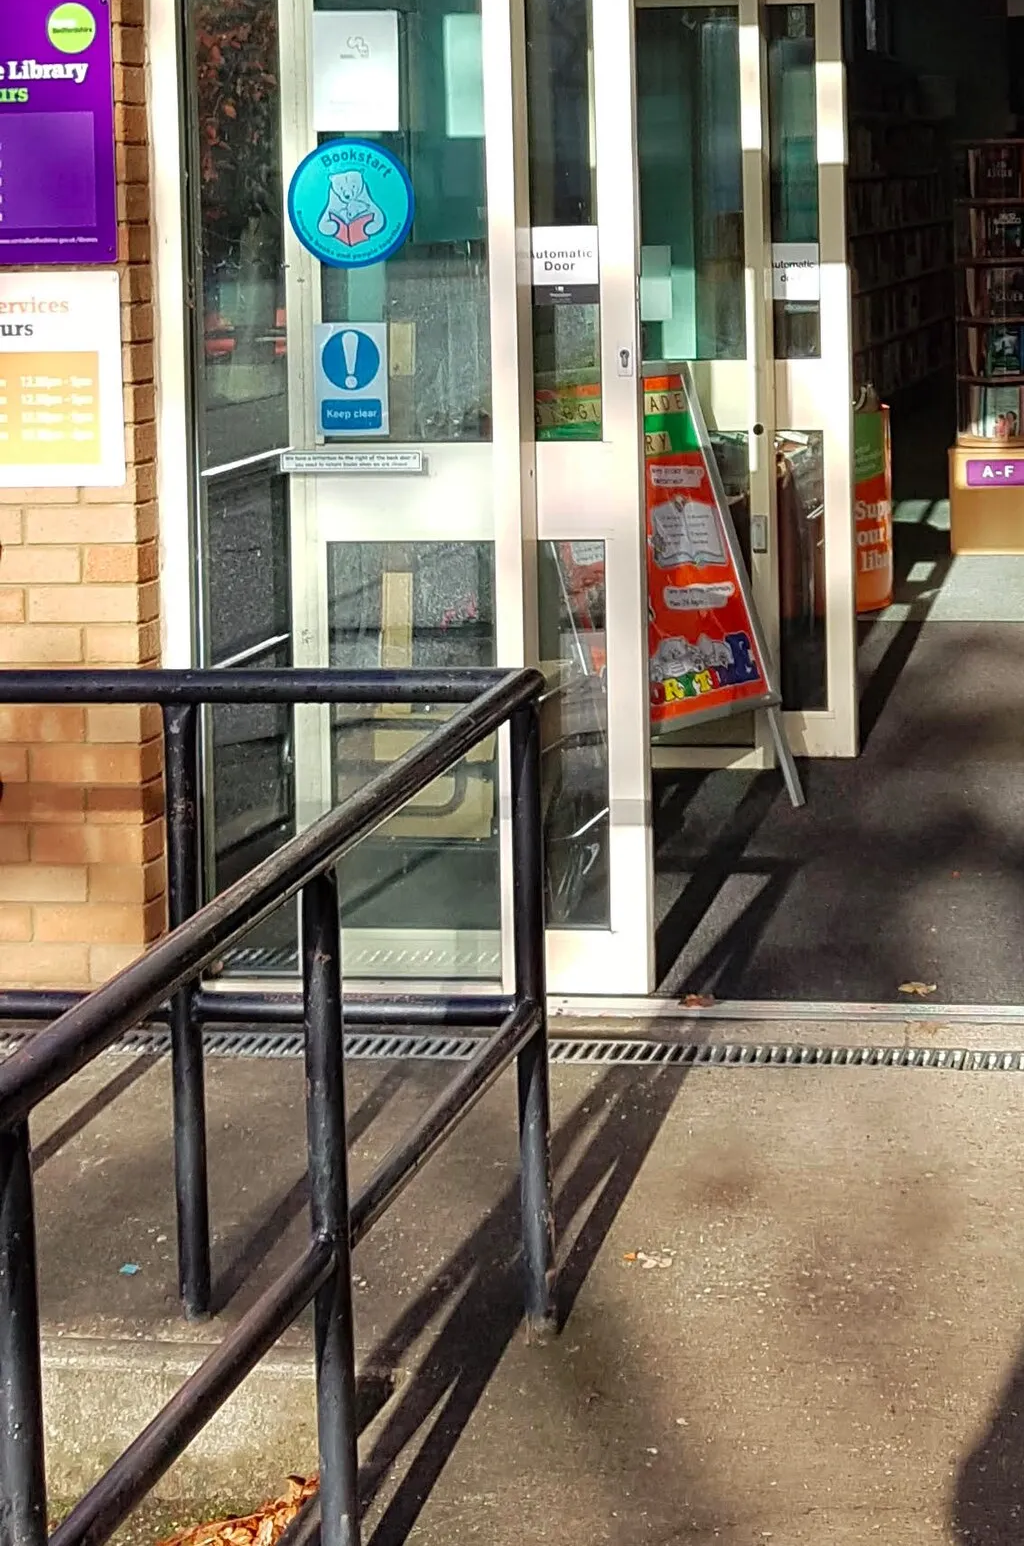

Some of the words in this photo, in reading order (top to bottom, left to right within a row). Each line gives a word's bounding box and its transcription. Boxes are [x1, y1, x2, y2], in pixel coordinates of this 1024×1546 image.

[8, 59, 89, 84] Library
[320, 147, 394, 178] Bookstart
[544, 261, 576, 272] Door
[326, 409, 352, 420] Keep
[354, 408, 378, 419] clear
